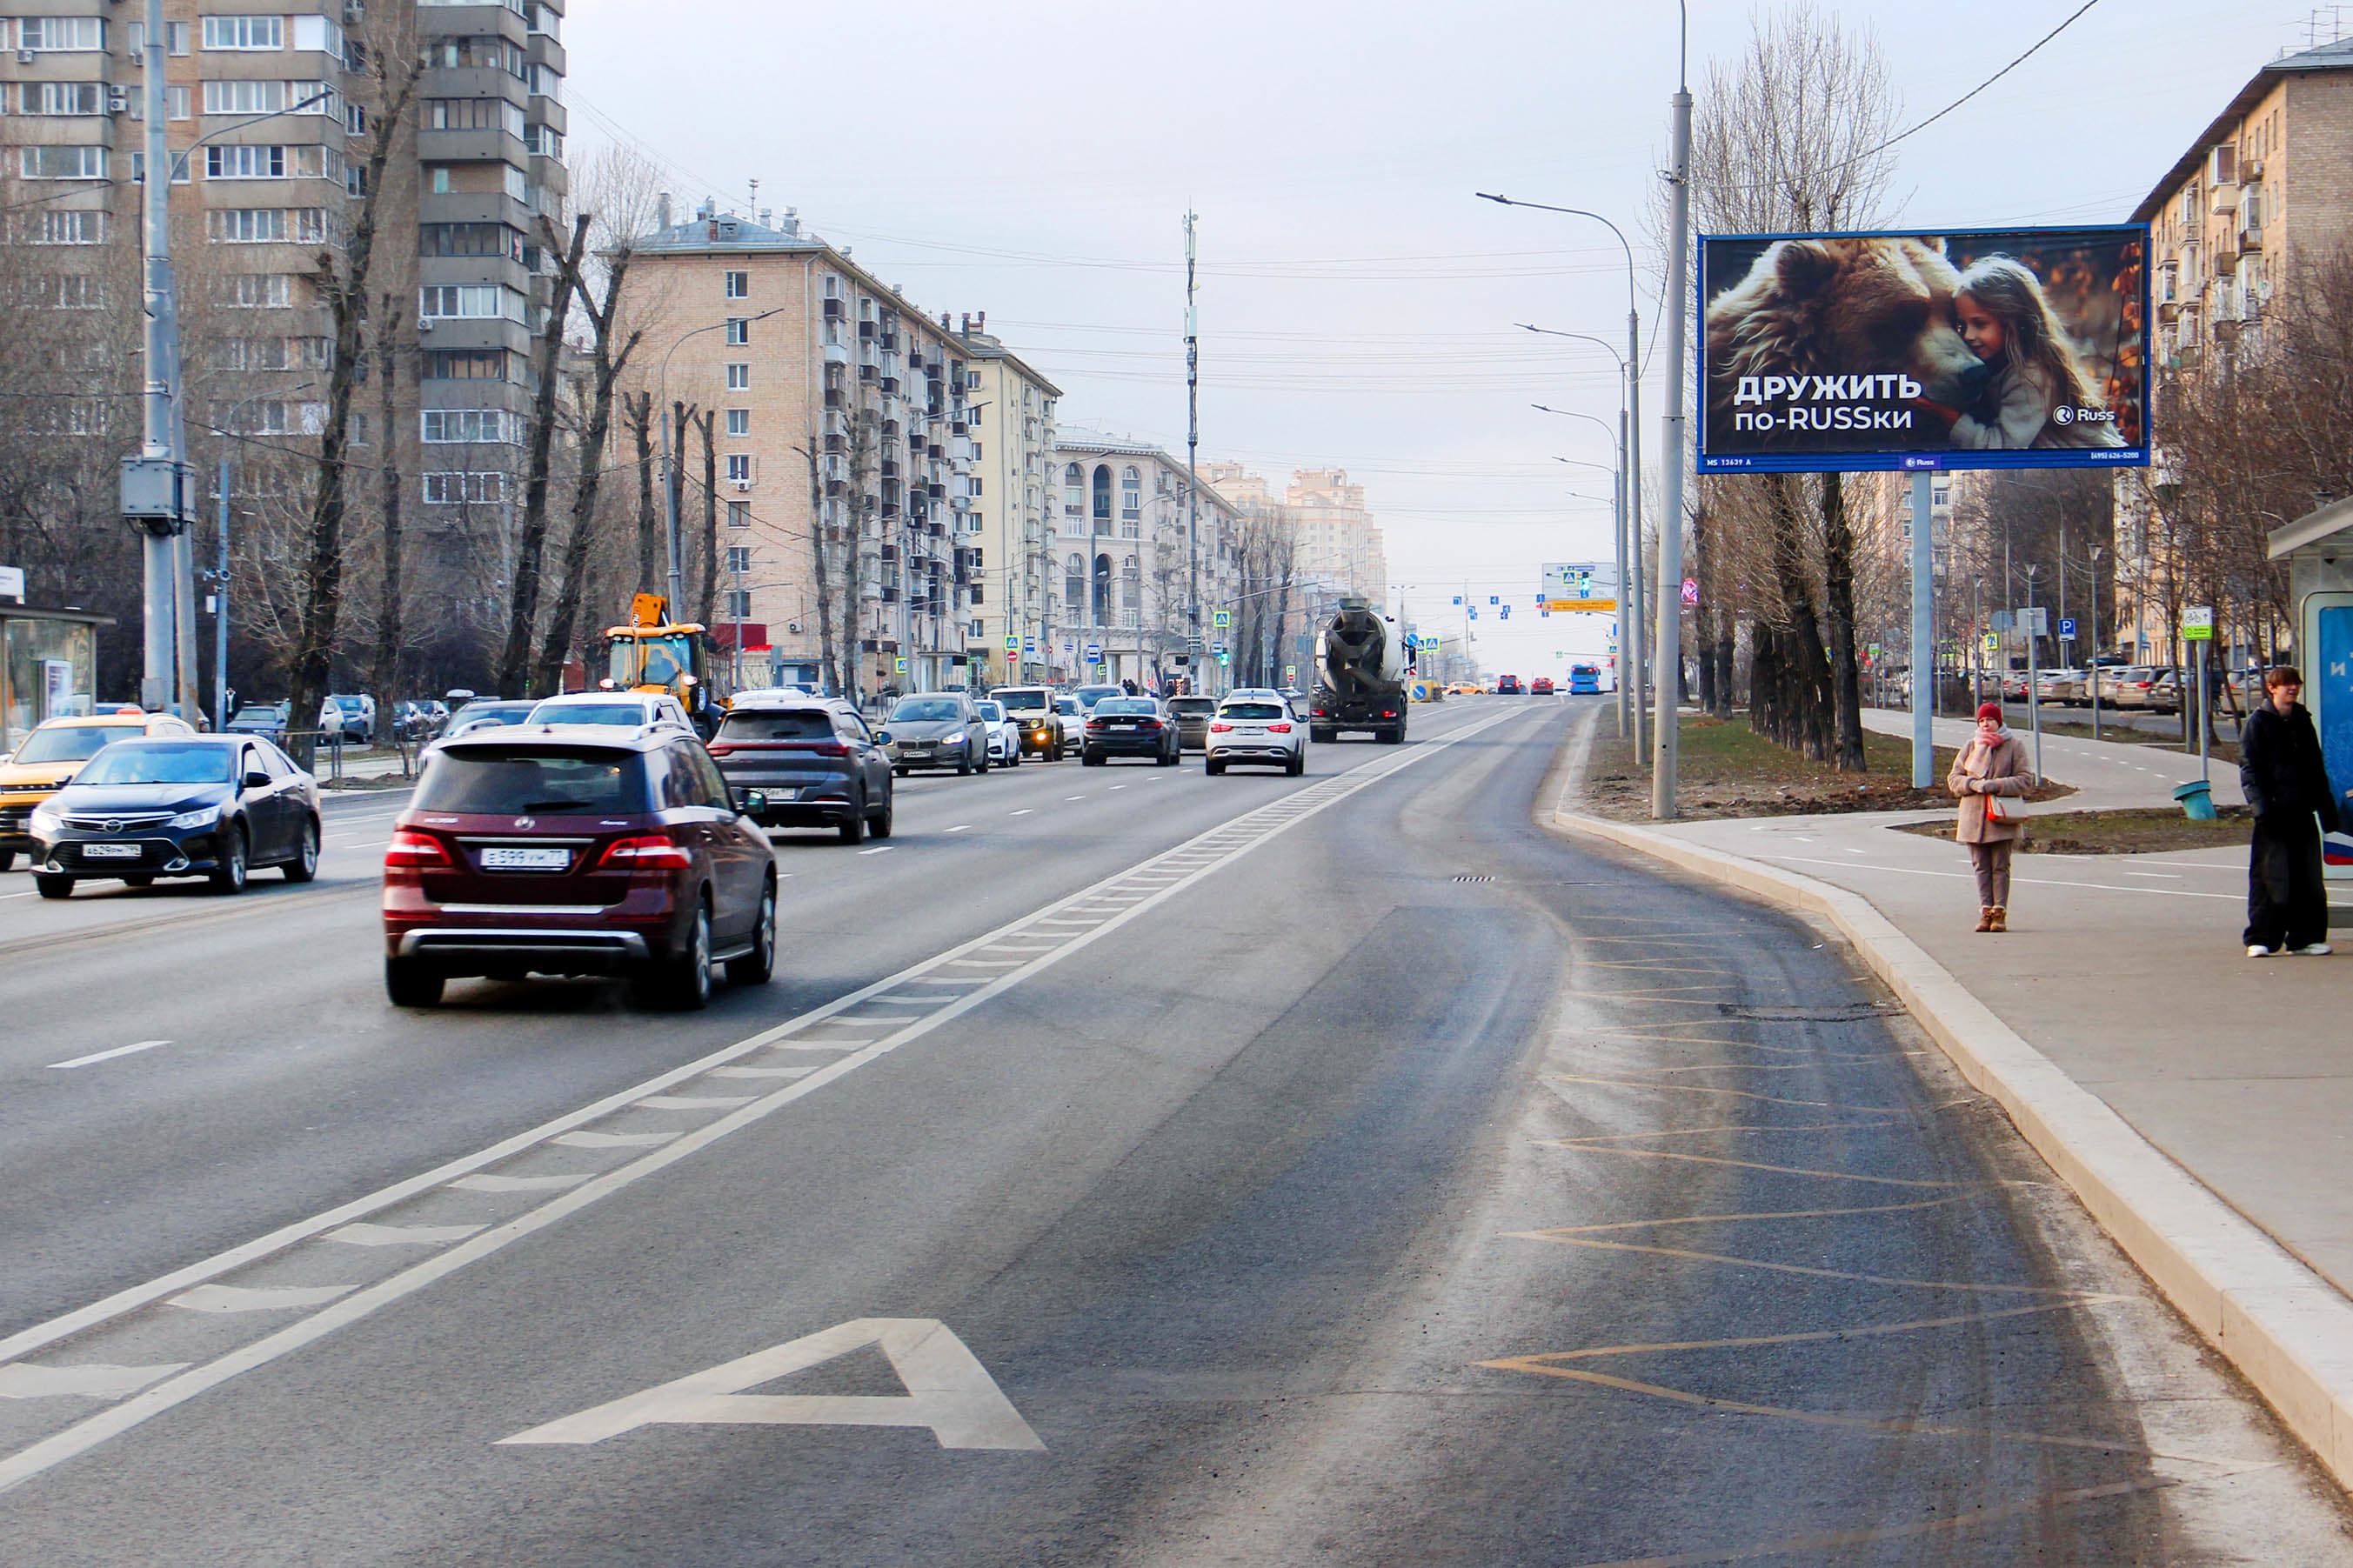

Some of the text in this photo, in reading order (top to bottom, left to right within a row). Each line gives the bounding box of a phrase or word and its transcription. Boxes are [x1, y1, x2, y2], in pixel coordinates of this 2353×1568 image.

[1734, 374, 1922, 405] ДРУЖИТЬ
[1735, 406, 1912, 430] по-RUSSки
[2077, 409, 2115, 422] Russ
[2062, 620, 2072, 633] P
